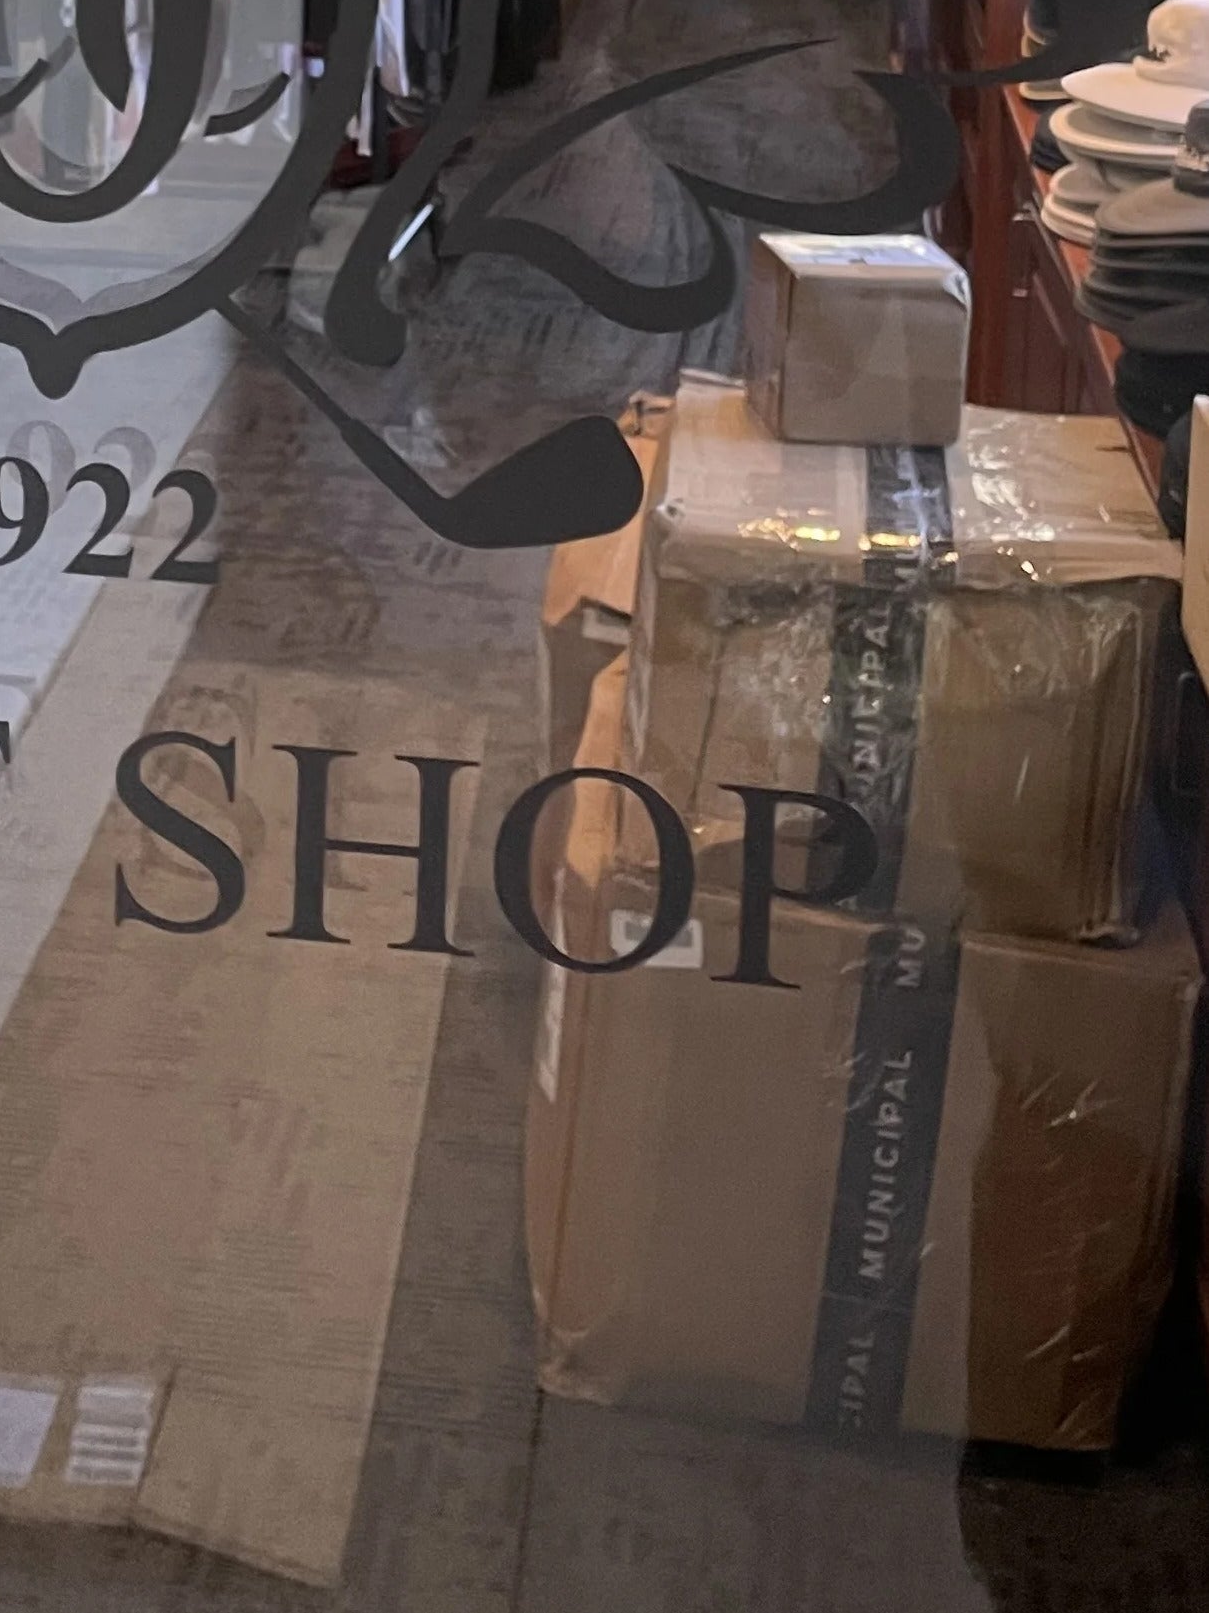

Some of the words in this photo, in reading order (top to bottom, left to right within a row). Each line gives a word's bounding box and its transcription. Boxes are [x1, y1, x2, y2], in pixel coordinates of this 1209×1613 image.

[849, 600, 892, 804] UNICIPAL
[114, 730, 879, 990] SHOP
[858, 1051, 913, 1280] MUNICIPAL
